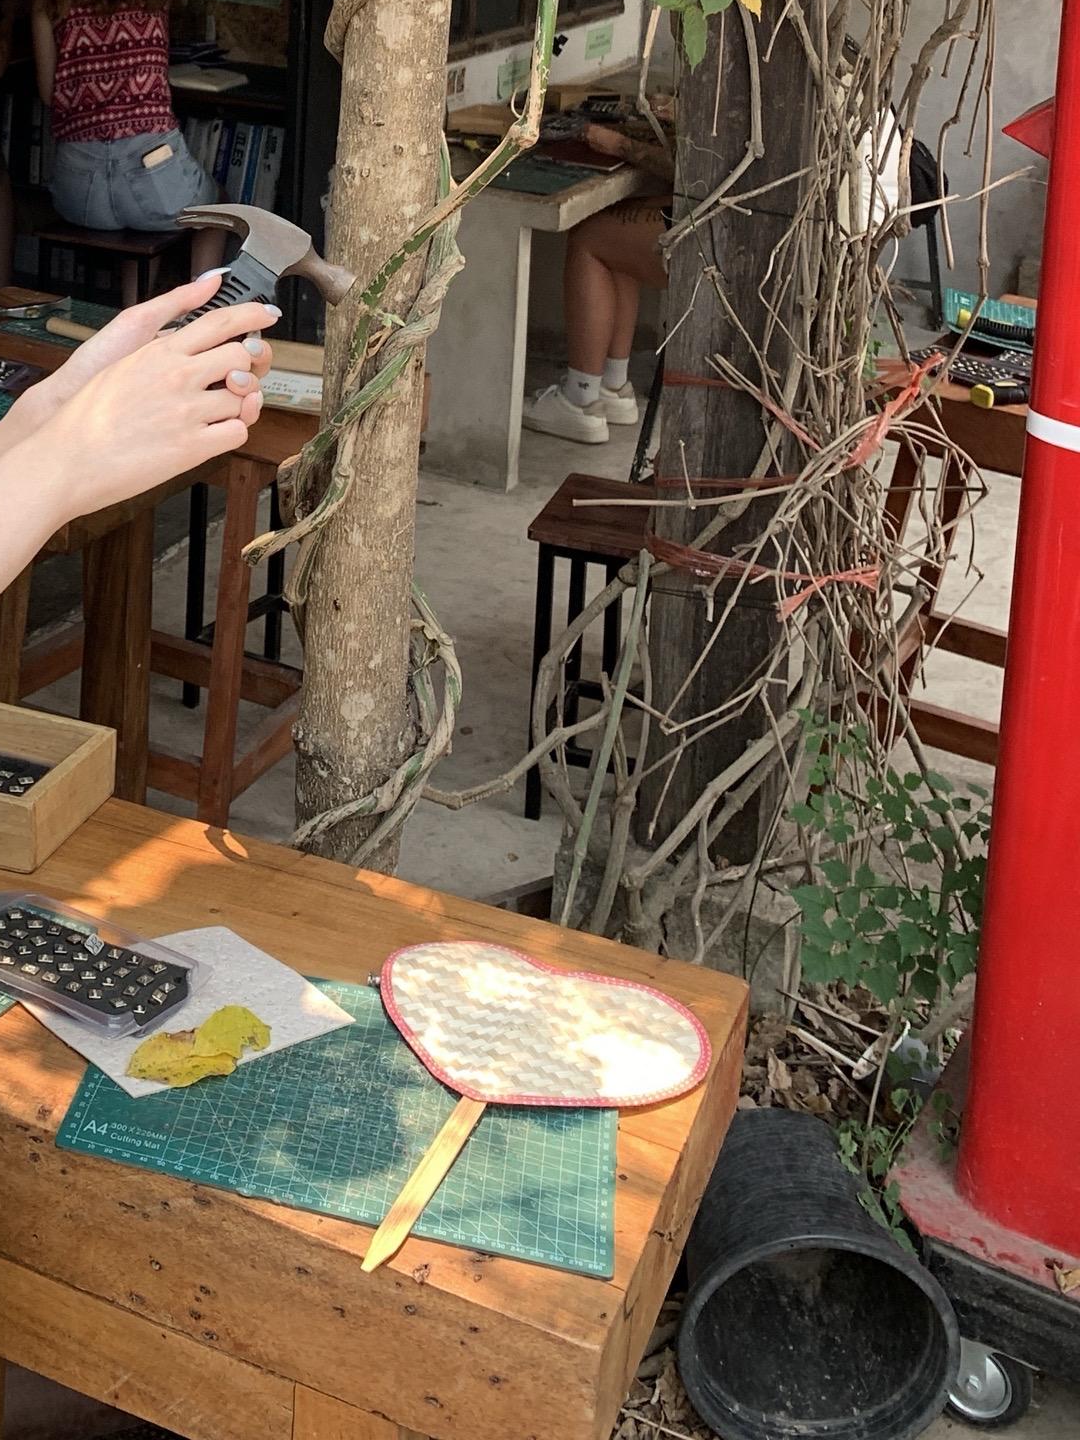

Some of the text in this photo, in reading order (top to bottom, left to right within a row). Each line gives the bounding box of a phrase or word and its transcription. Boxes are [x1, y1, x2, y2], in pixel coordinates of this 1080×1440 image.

[83, 1120, 108, 1136] A4
[110, 1122, 127, 1132] 300
[110, 1132, 160, 1150] Cutting Mat
